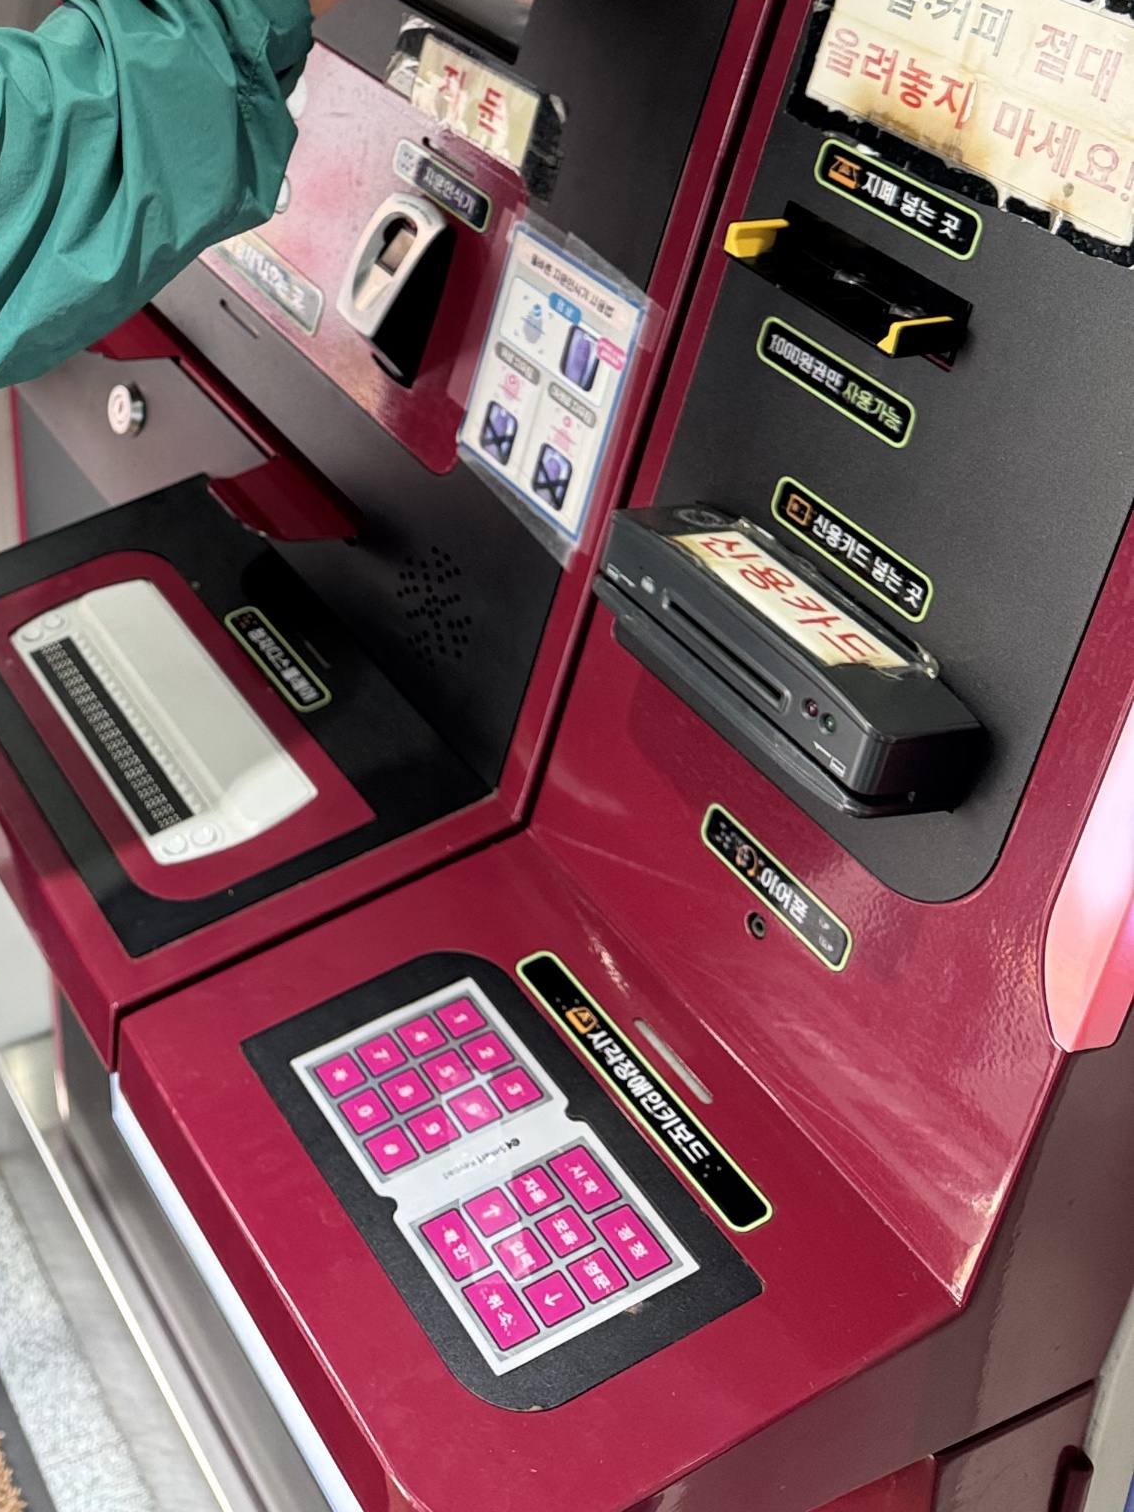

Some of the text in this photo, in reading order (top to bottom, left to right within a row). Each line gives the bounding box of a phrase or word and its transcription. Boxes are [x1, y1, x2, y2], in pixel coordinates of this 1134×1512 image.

[1035, 23, 1123, 103] 절대
[827, 28, 1134, 203] 올려놓지 마세요!
[422, 166, 476, 215] 지문인식기
[861, 171, 962, 240] 지폐 넣는 곳
[768, 333, 904, 434] 1000원권만 사용가능
[812, 514, 924, 609] 신용카드 넣는 곳
[700, 535, 881, 664] 신용카드
[248, 627, 320, 703] 점자디스플레이
[760, 867, 809, 925] 이어폰
[587, 1027, 711, 1164] 시각장애인키보드
[521, 1176, 547, 1204] 자음
[569, 1164, 600, 1195] 시작
[443, 1228, 469, 1261] 확인
[508, 1240, 537, 1269] 입력
[552, 1217, 579, 1246] 모음
[582, 1260, 612, 1291] 영문
[486, 1291, 514, 1330] 취소
